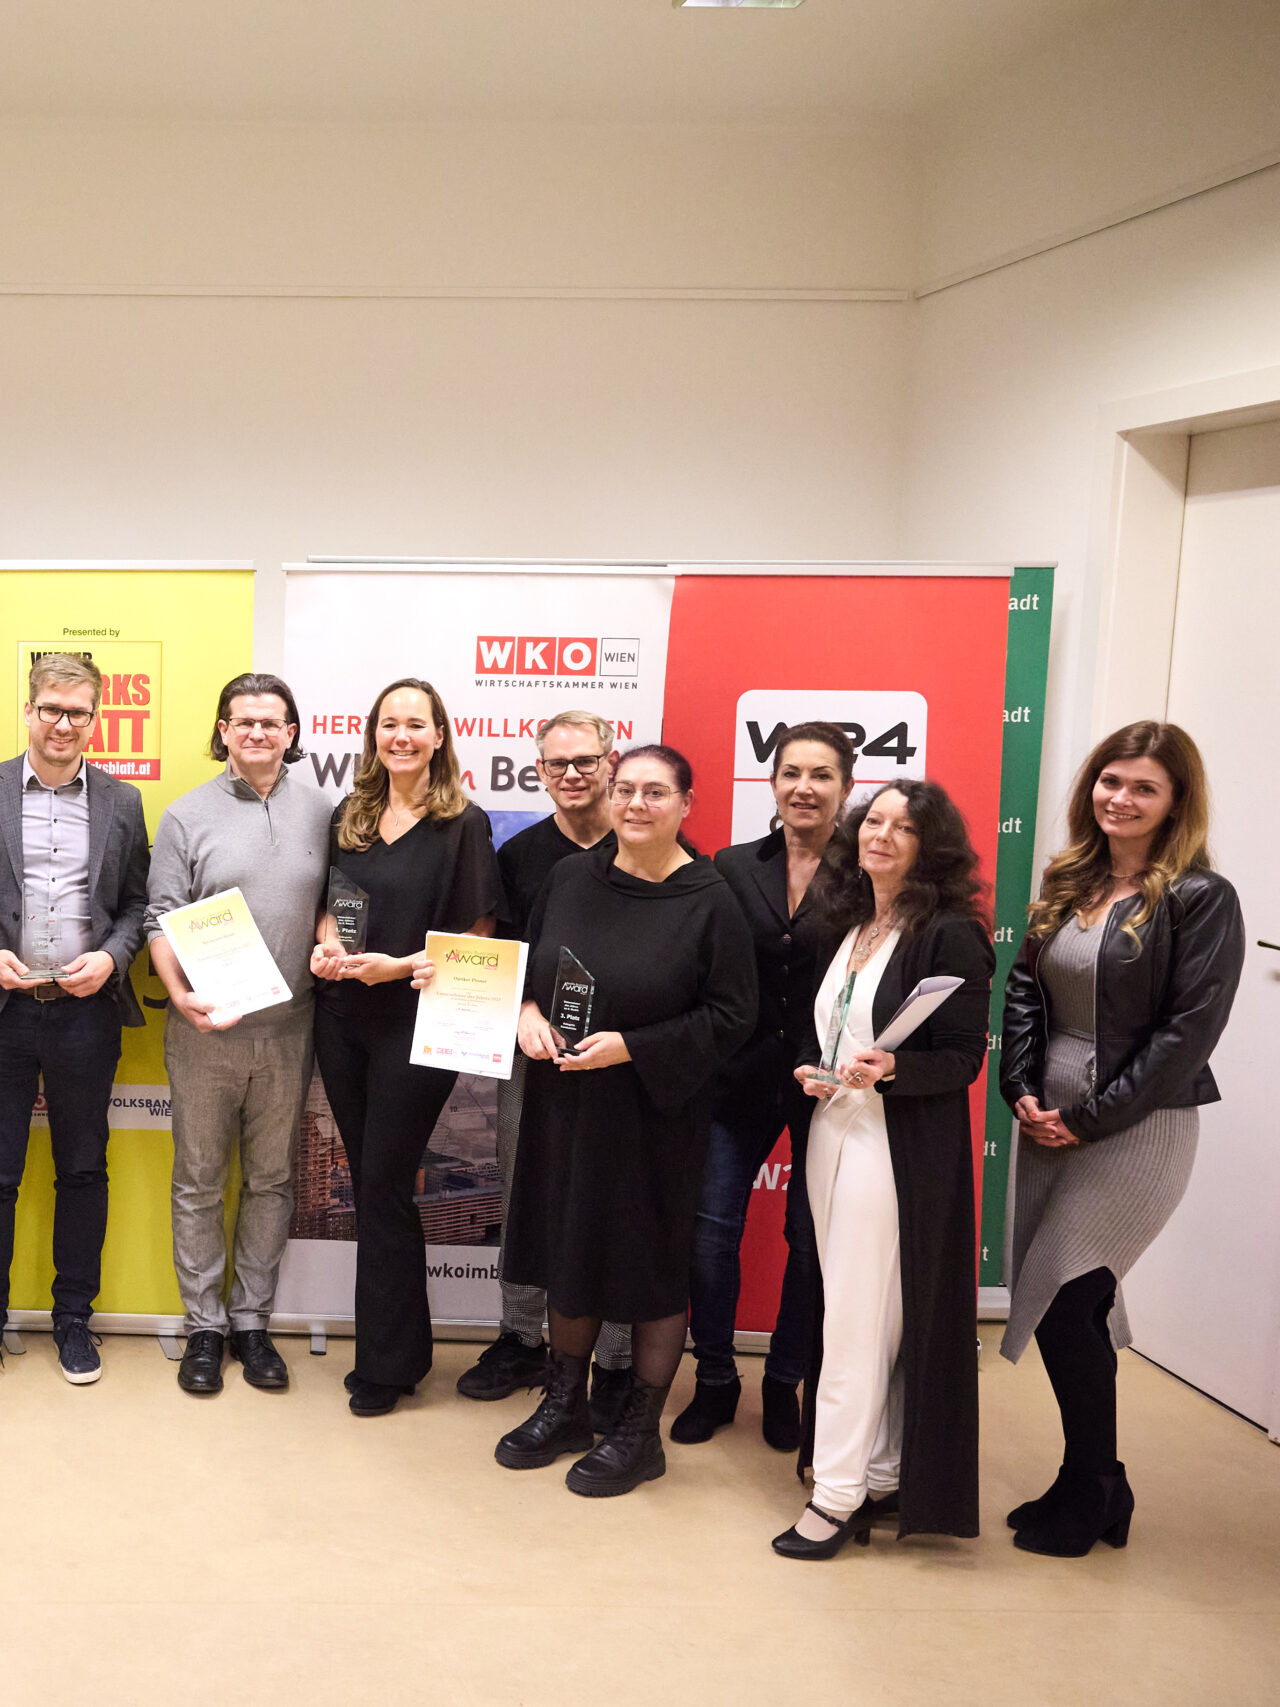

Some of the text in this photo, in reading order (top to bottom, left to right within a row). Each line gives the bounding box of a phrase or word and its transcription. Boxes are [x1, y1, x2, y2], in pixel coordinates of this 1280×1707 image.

[62, 628, 120, 638] Presented by
[478, 641, 636, 671] WKO WIEN
[475, 679, 638, 690] WIRTSCHAFTSKAMMER WIEN
[82, 709, 151, 753] ATT
[446, 949, 499, 967] Award
